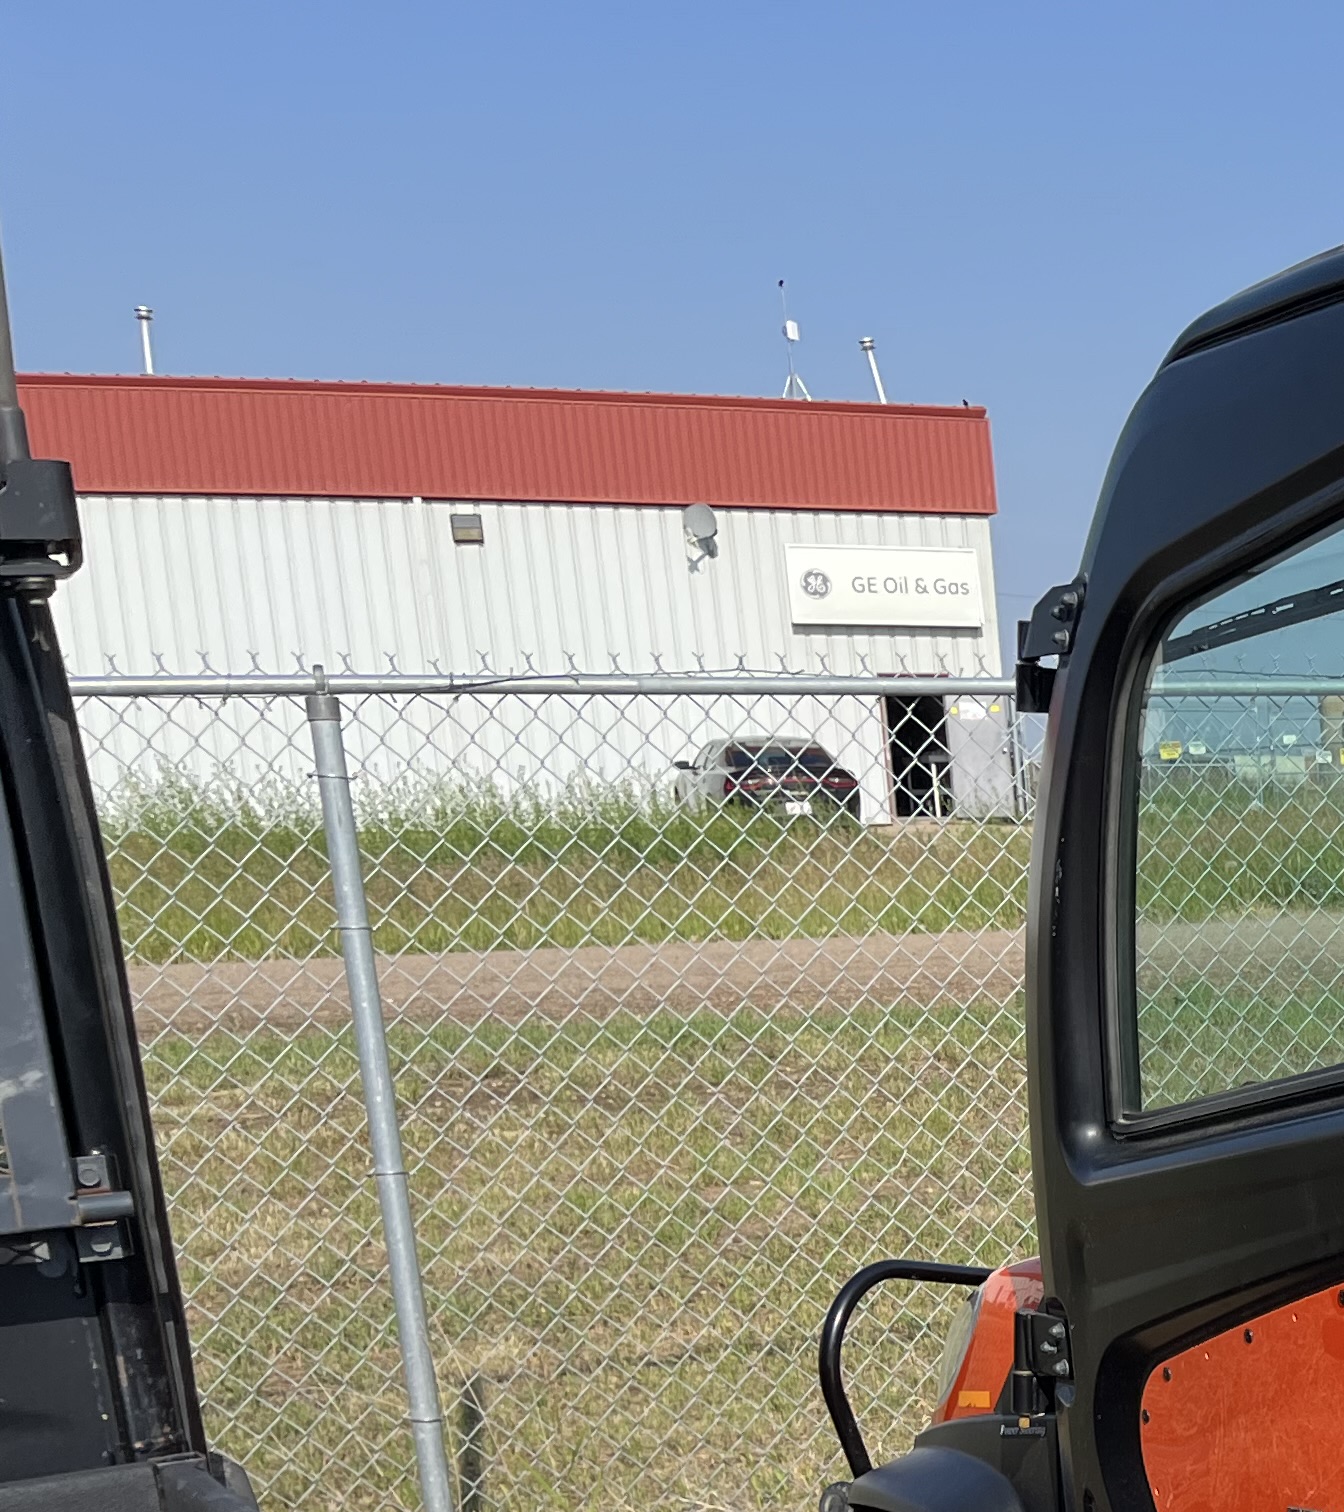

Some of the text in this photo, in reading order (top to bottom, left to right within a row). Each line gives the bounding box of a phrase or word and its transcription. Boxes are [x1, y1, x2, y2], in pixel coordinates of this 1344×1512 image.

[851, 575, 970, 596] GE Oil & Gas
